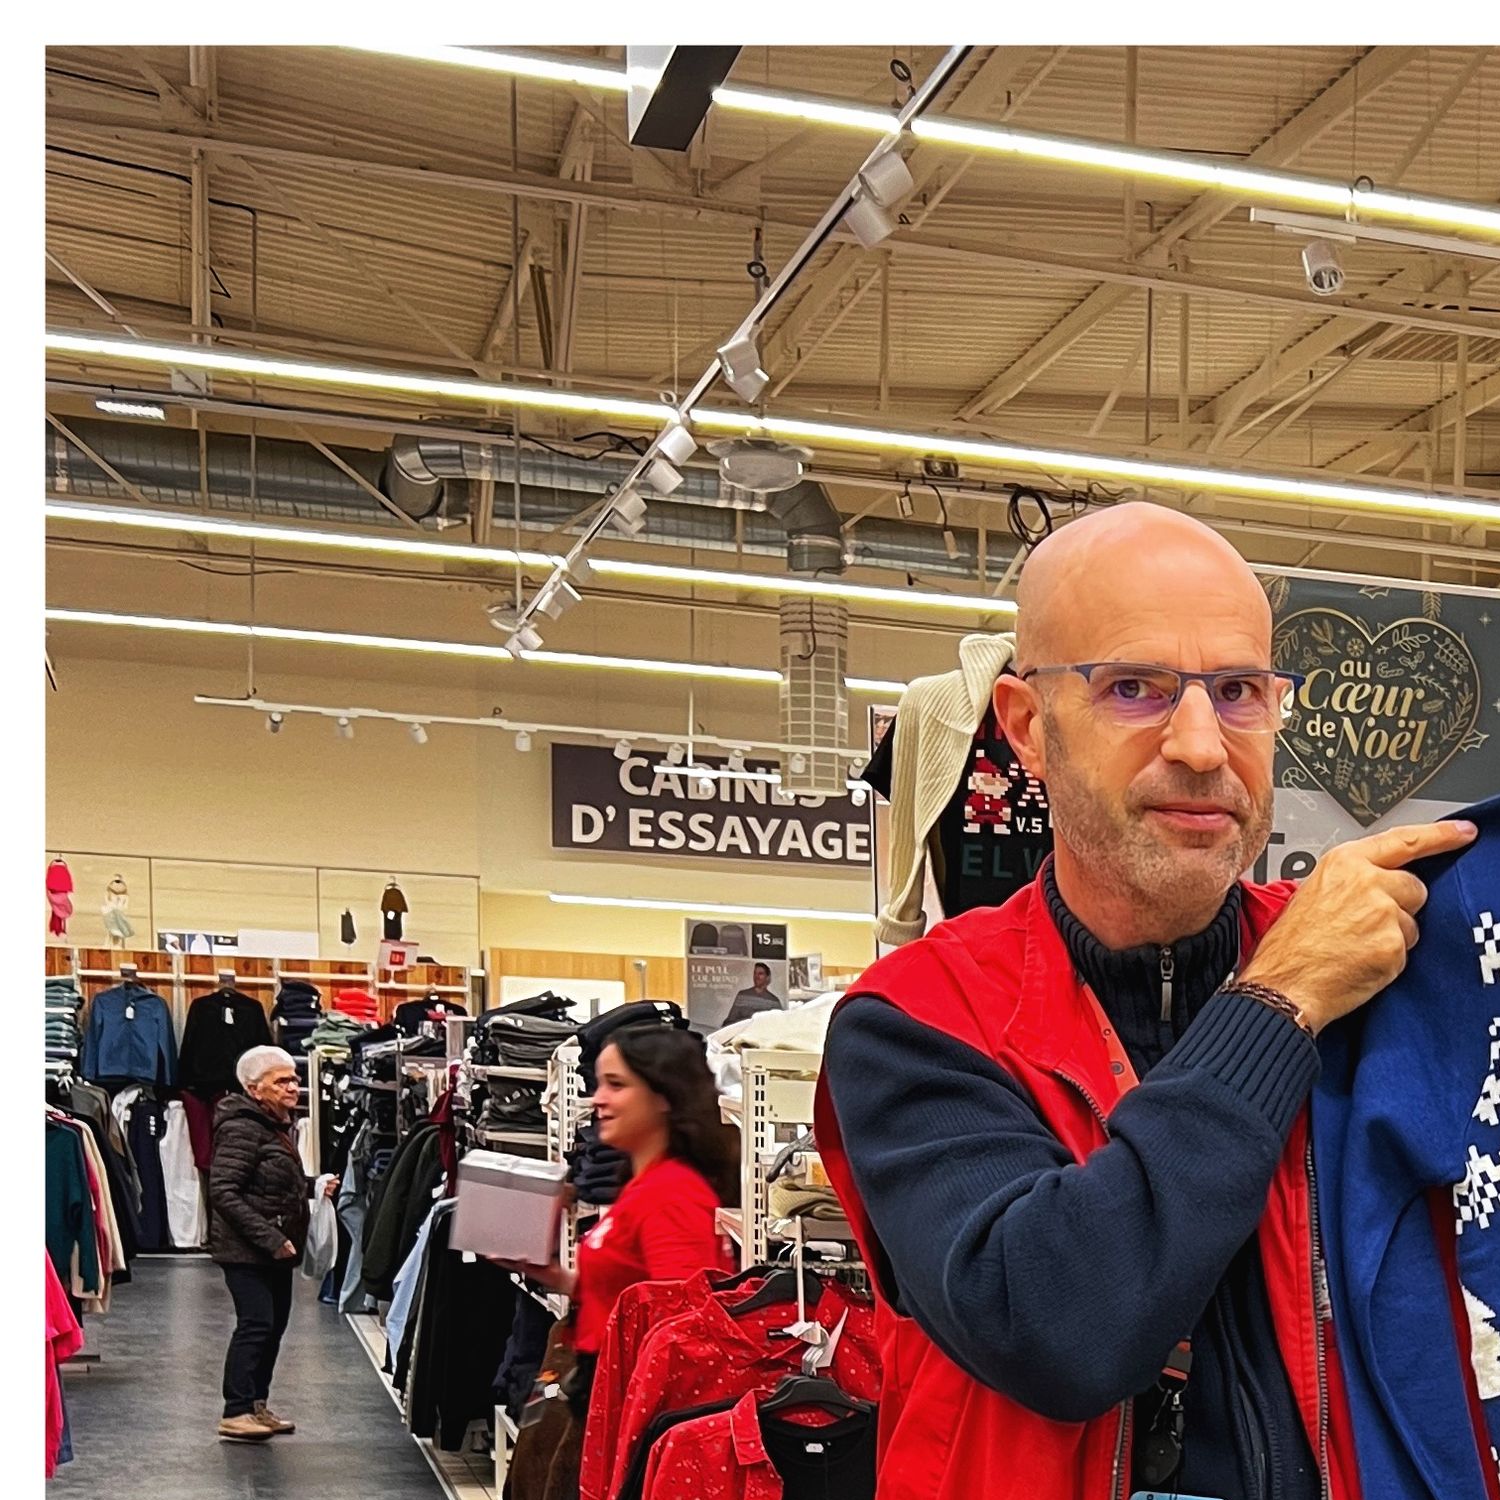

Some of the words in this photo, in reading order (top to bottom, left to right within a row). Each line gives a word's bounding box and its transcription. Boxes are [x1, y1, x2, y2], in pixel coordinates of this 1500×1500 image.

[1299, 667, 1425, 718] Cœur
[1340, 659, 1371, 679] au
[1306, 713, 1336, 739] de
[1326, 716, 1429, 763] Noël
[628, 807, 871, 862] ESSAYAGE
[1253, 832, 1318, 884] Te
[961, 843, 1046, 880] ELV
[756, 933, 771, 946] 15
